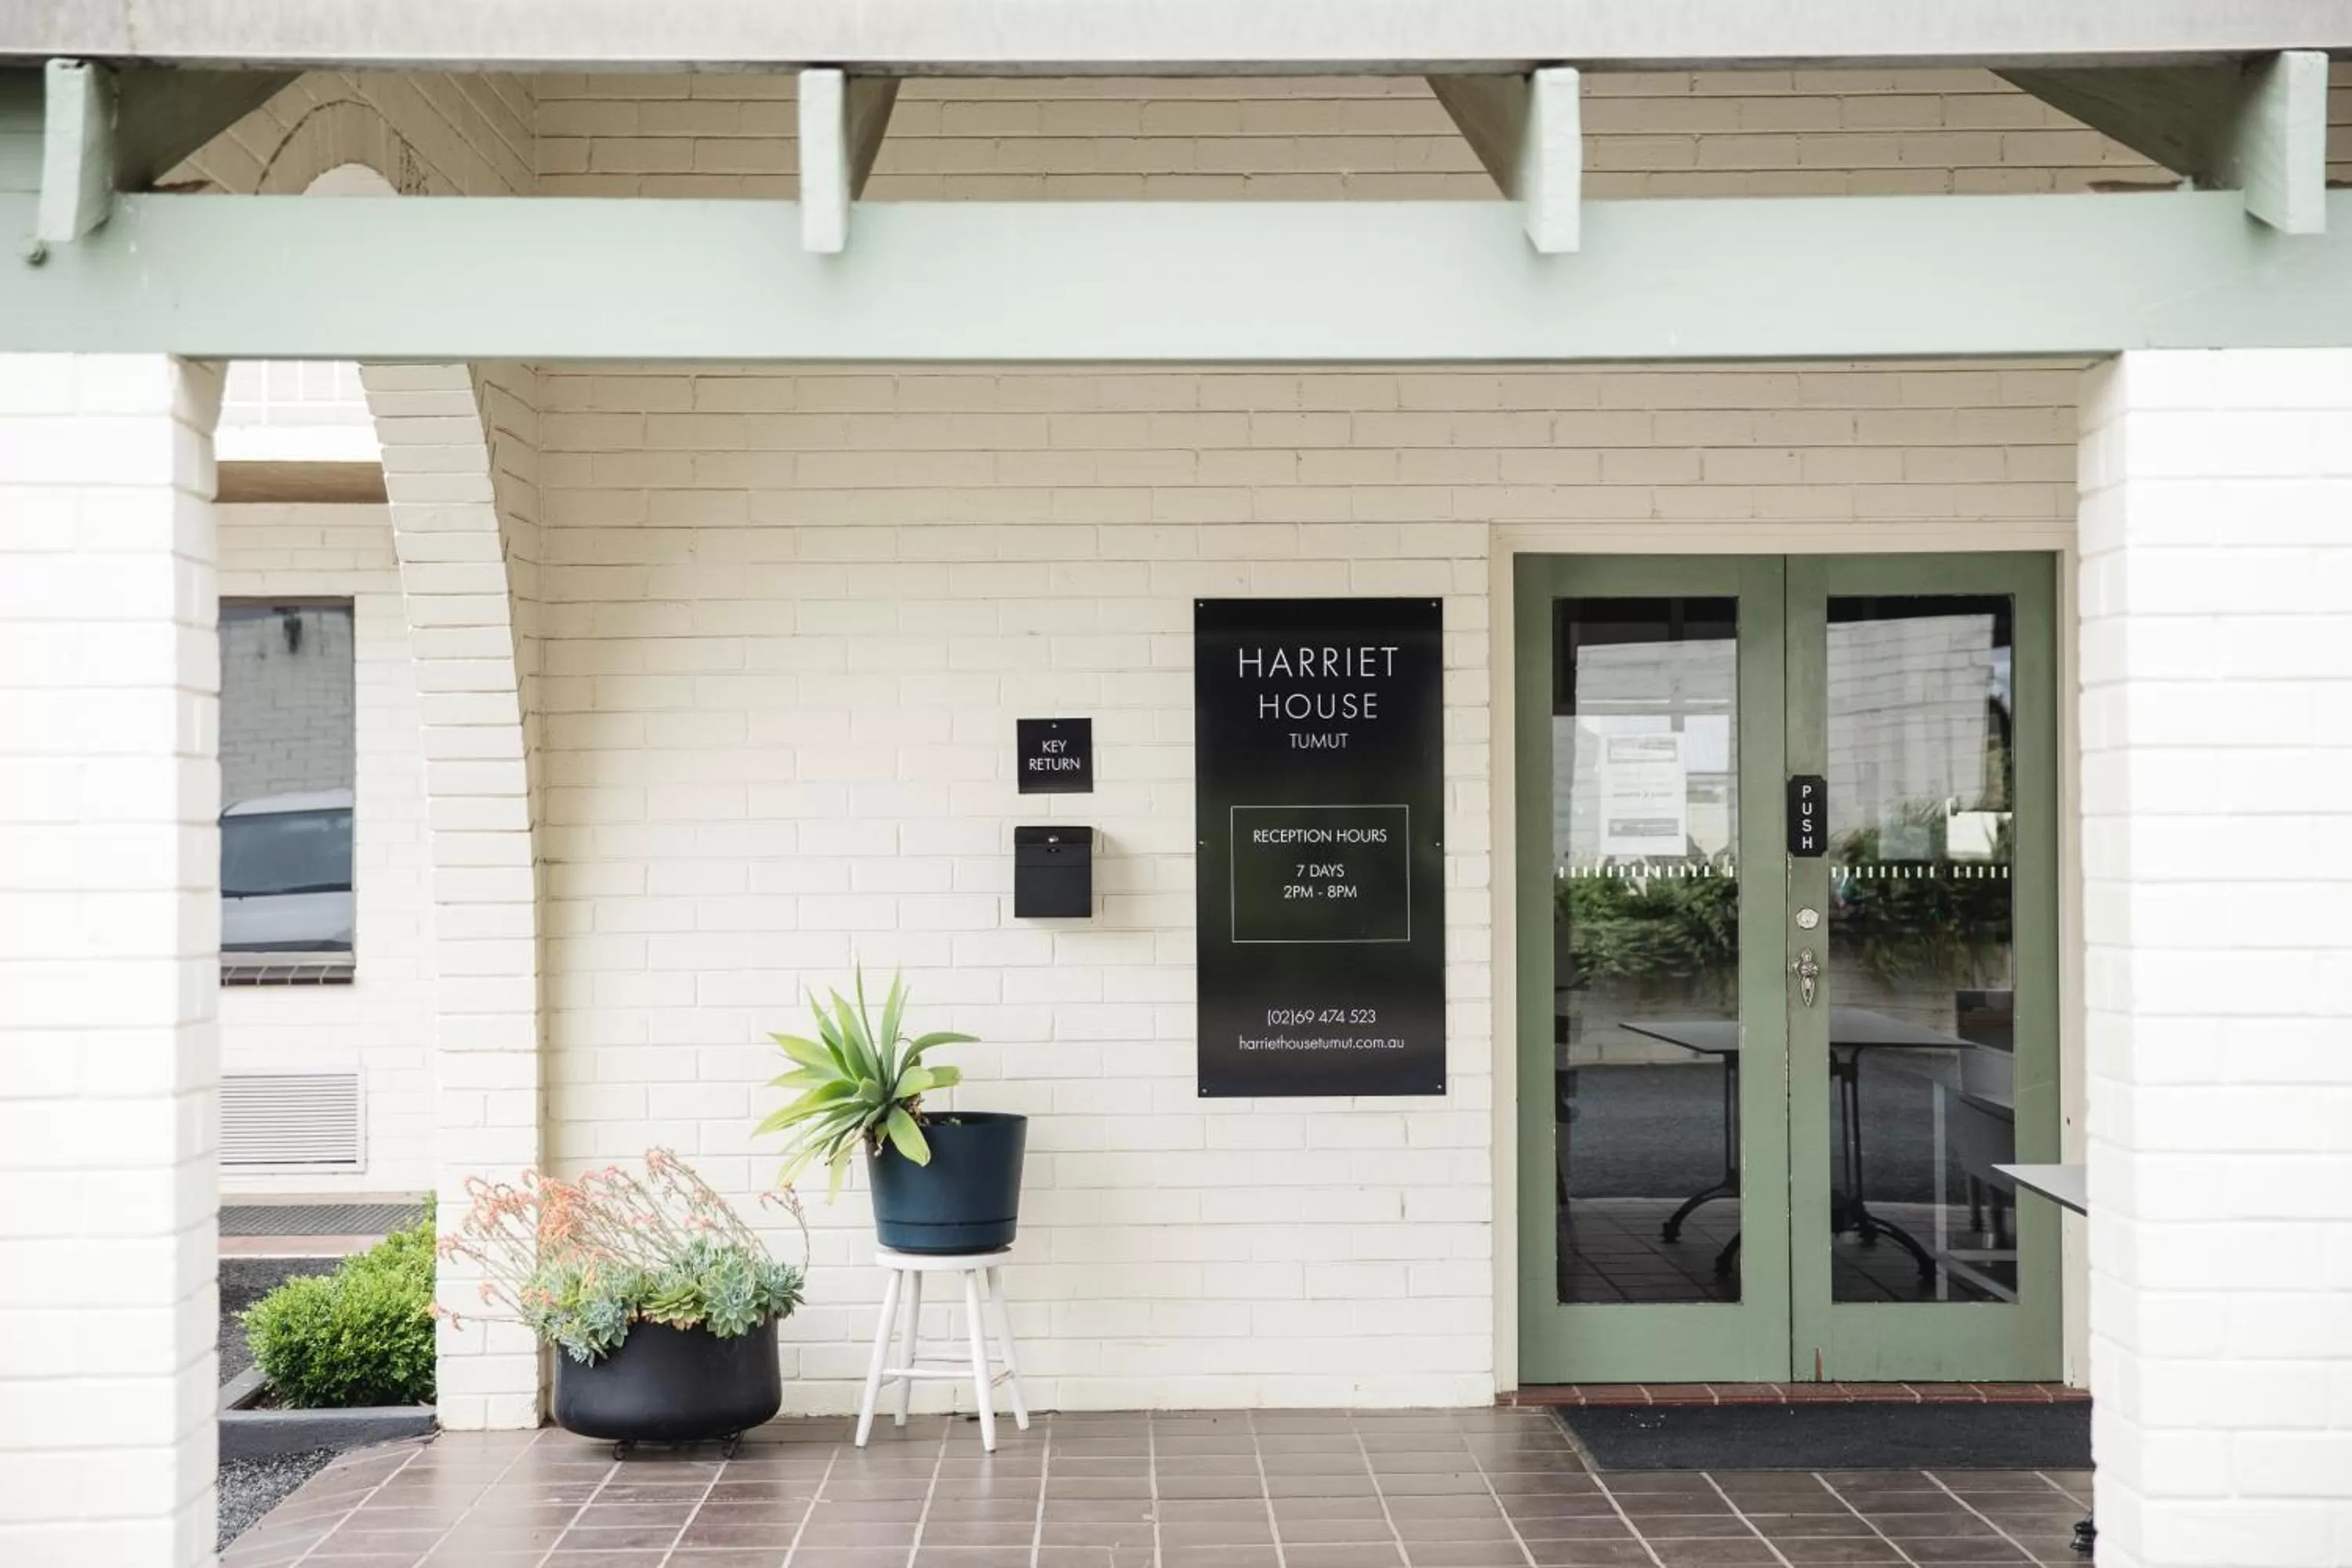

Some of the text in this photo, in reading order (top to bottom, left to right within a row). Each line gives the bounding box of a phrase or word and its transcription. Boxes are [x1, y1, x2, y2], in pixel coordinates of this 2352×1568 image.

[1239, 647, 1399, 678] HARRIET
[1260, 693, 1378, 719] HOUSE
[1042, 739, 1067, 753] KEY
[1289, 733, 1348, 749] TUMUT
[1029, 757, 1080, 771] RETURN
[1802, 785, 1813, 849] PUSH
[1254, 829, 1387, 843] RECEPTION HOURS
[1296, 863, 1345, 878] 7 DAYS
[1283, 885, 1313, 898] 2PM
[1327, 884, 1357, 898] 8PM
[1267, 1009, 1376, 1026] (02)69 474 523
[1239, 1034, 1405, 1051] harriethousetumut.com.au
